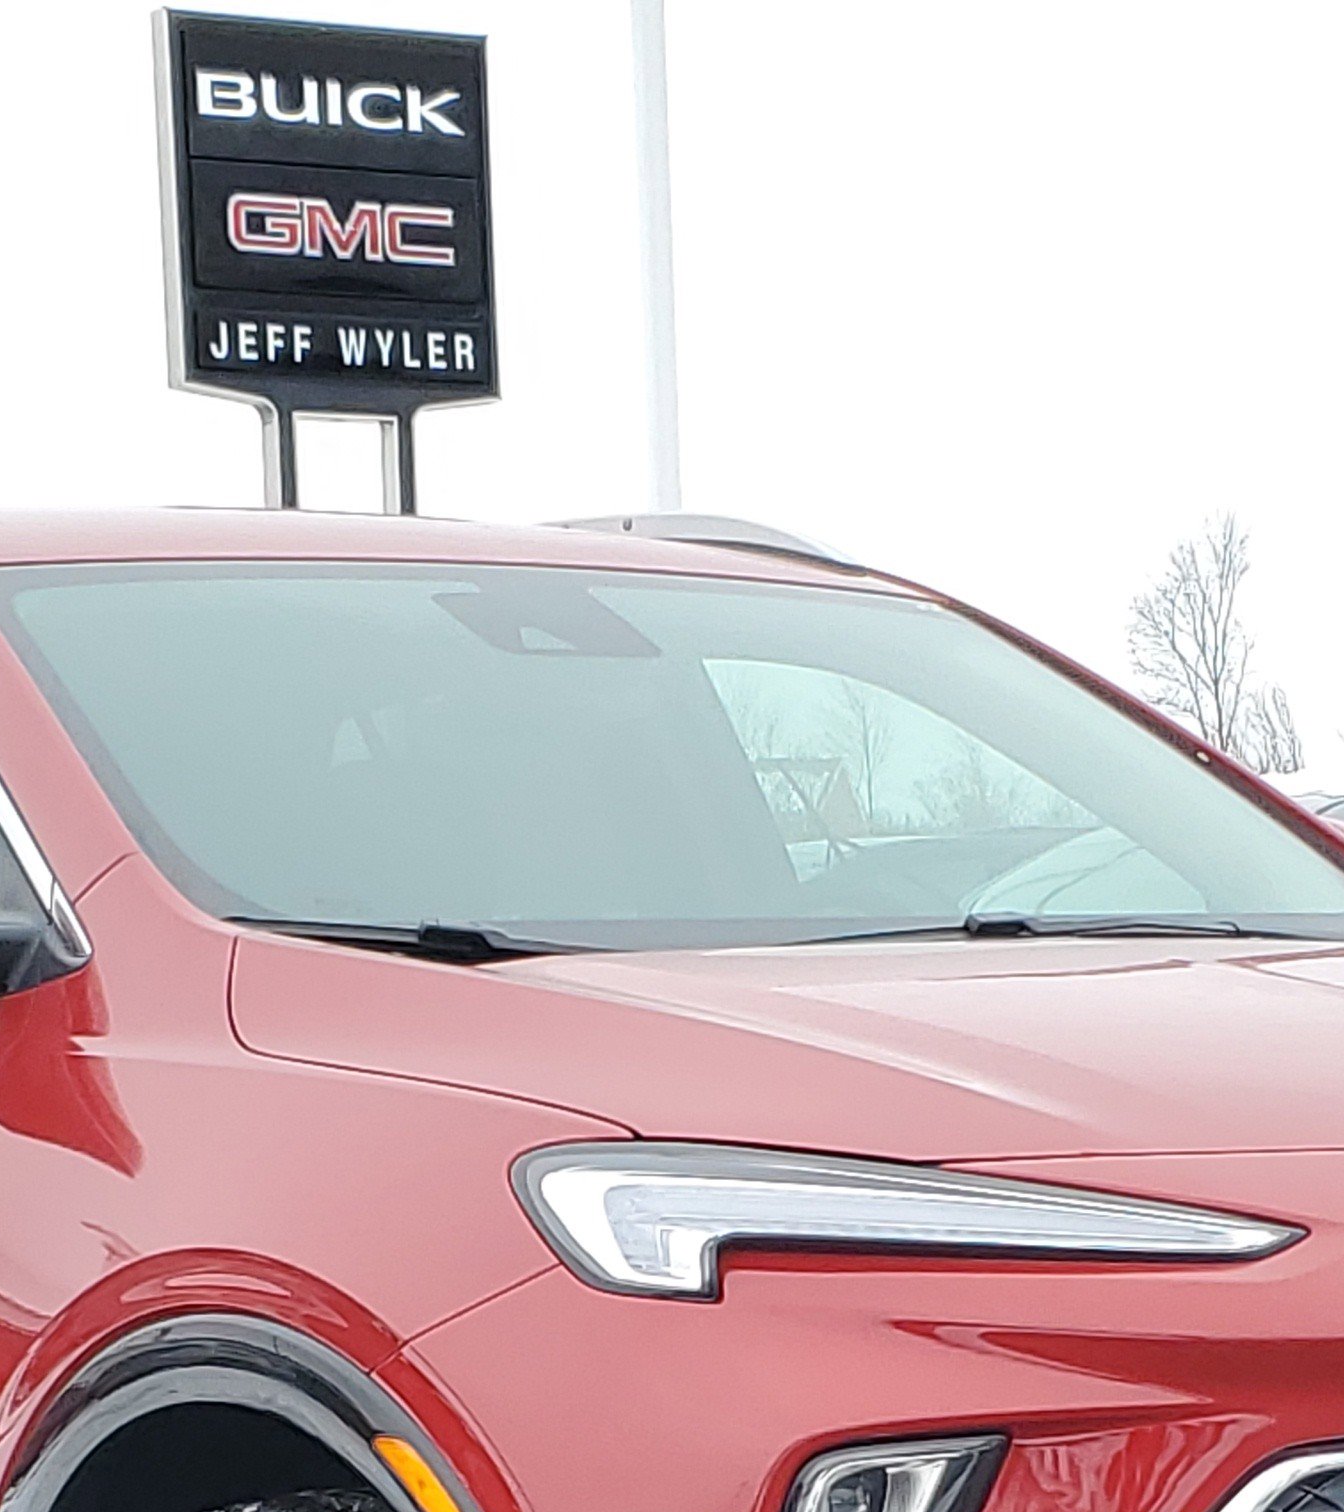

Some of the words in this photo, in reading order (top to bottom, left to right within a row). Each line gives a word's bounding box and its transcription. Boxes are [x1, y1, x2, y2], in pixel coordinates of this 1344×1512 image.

[195, 66, 466, 136] BUICK
[227, 193, 455, 266] GMC
[209, 320, 312, 363] JEFF
[338, 326, 475, 370] WYLER
